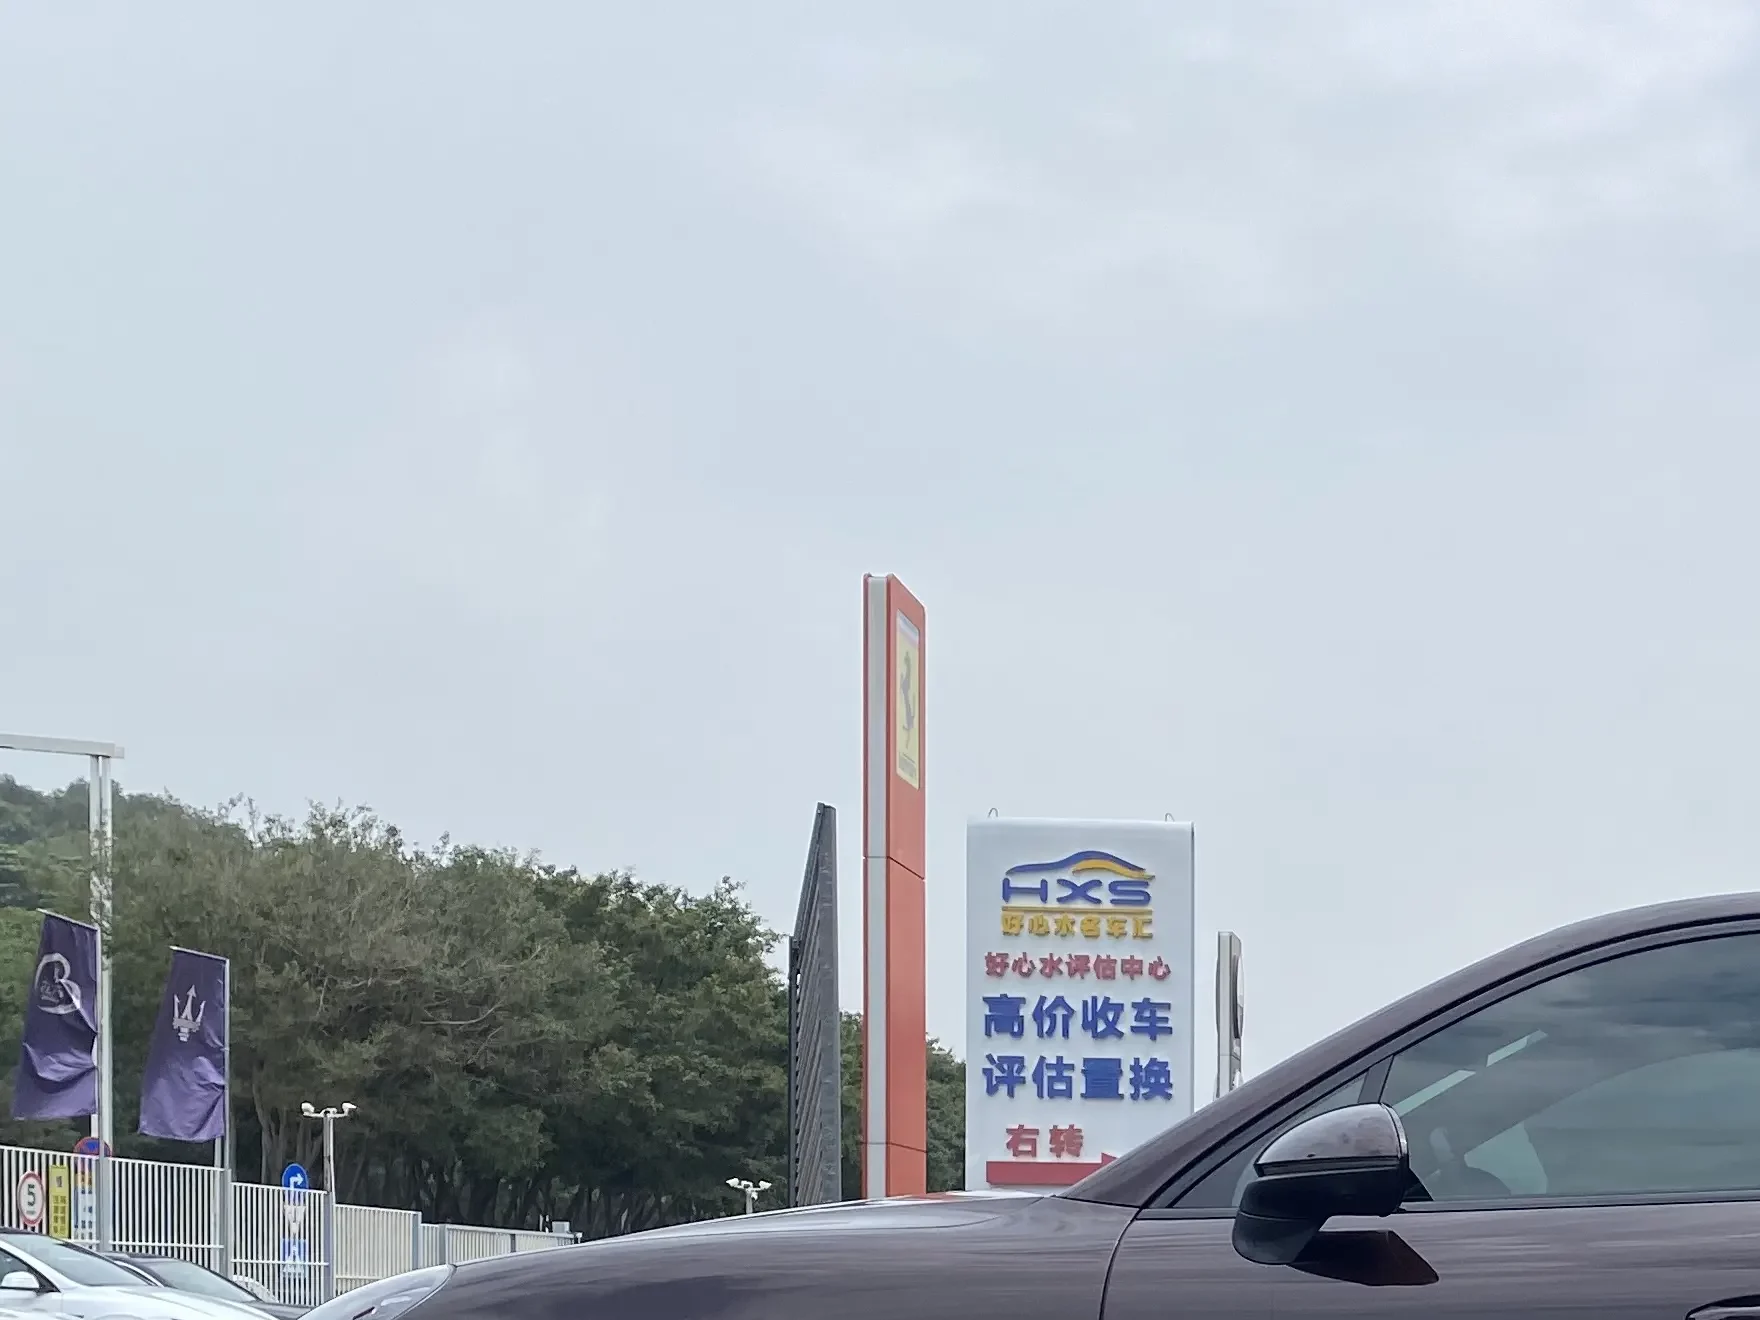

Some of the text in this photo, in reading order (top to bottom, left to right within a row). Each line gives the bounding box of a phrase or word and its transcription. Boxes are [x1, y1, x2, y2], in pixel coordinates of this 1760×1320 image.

[1002, 877, 1151, 905] HXS
[984, 951, 1172, 981] 好心水评估中心
[982, 993, 1173, 1041] 高价收车
[982, 1053, 1173, 1101] 评估置换
[1006, 1124, 1084, 1158] 右转
[27, 1183, 36, 1207] 5
